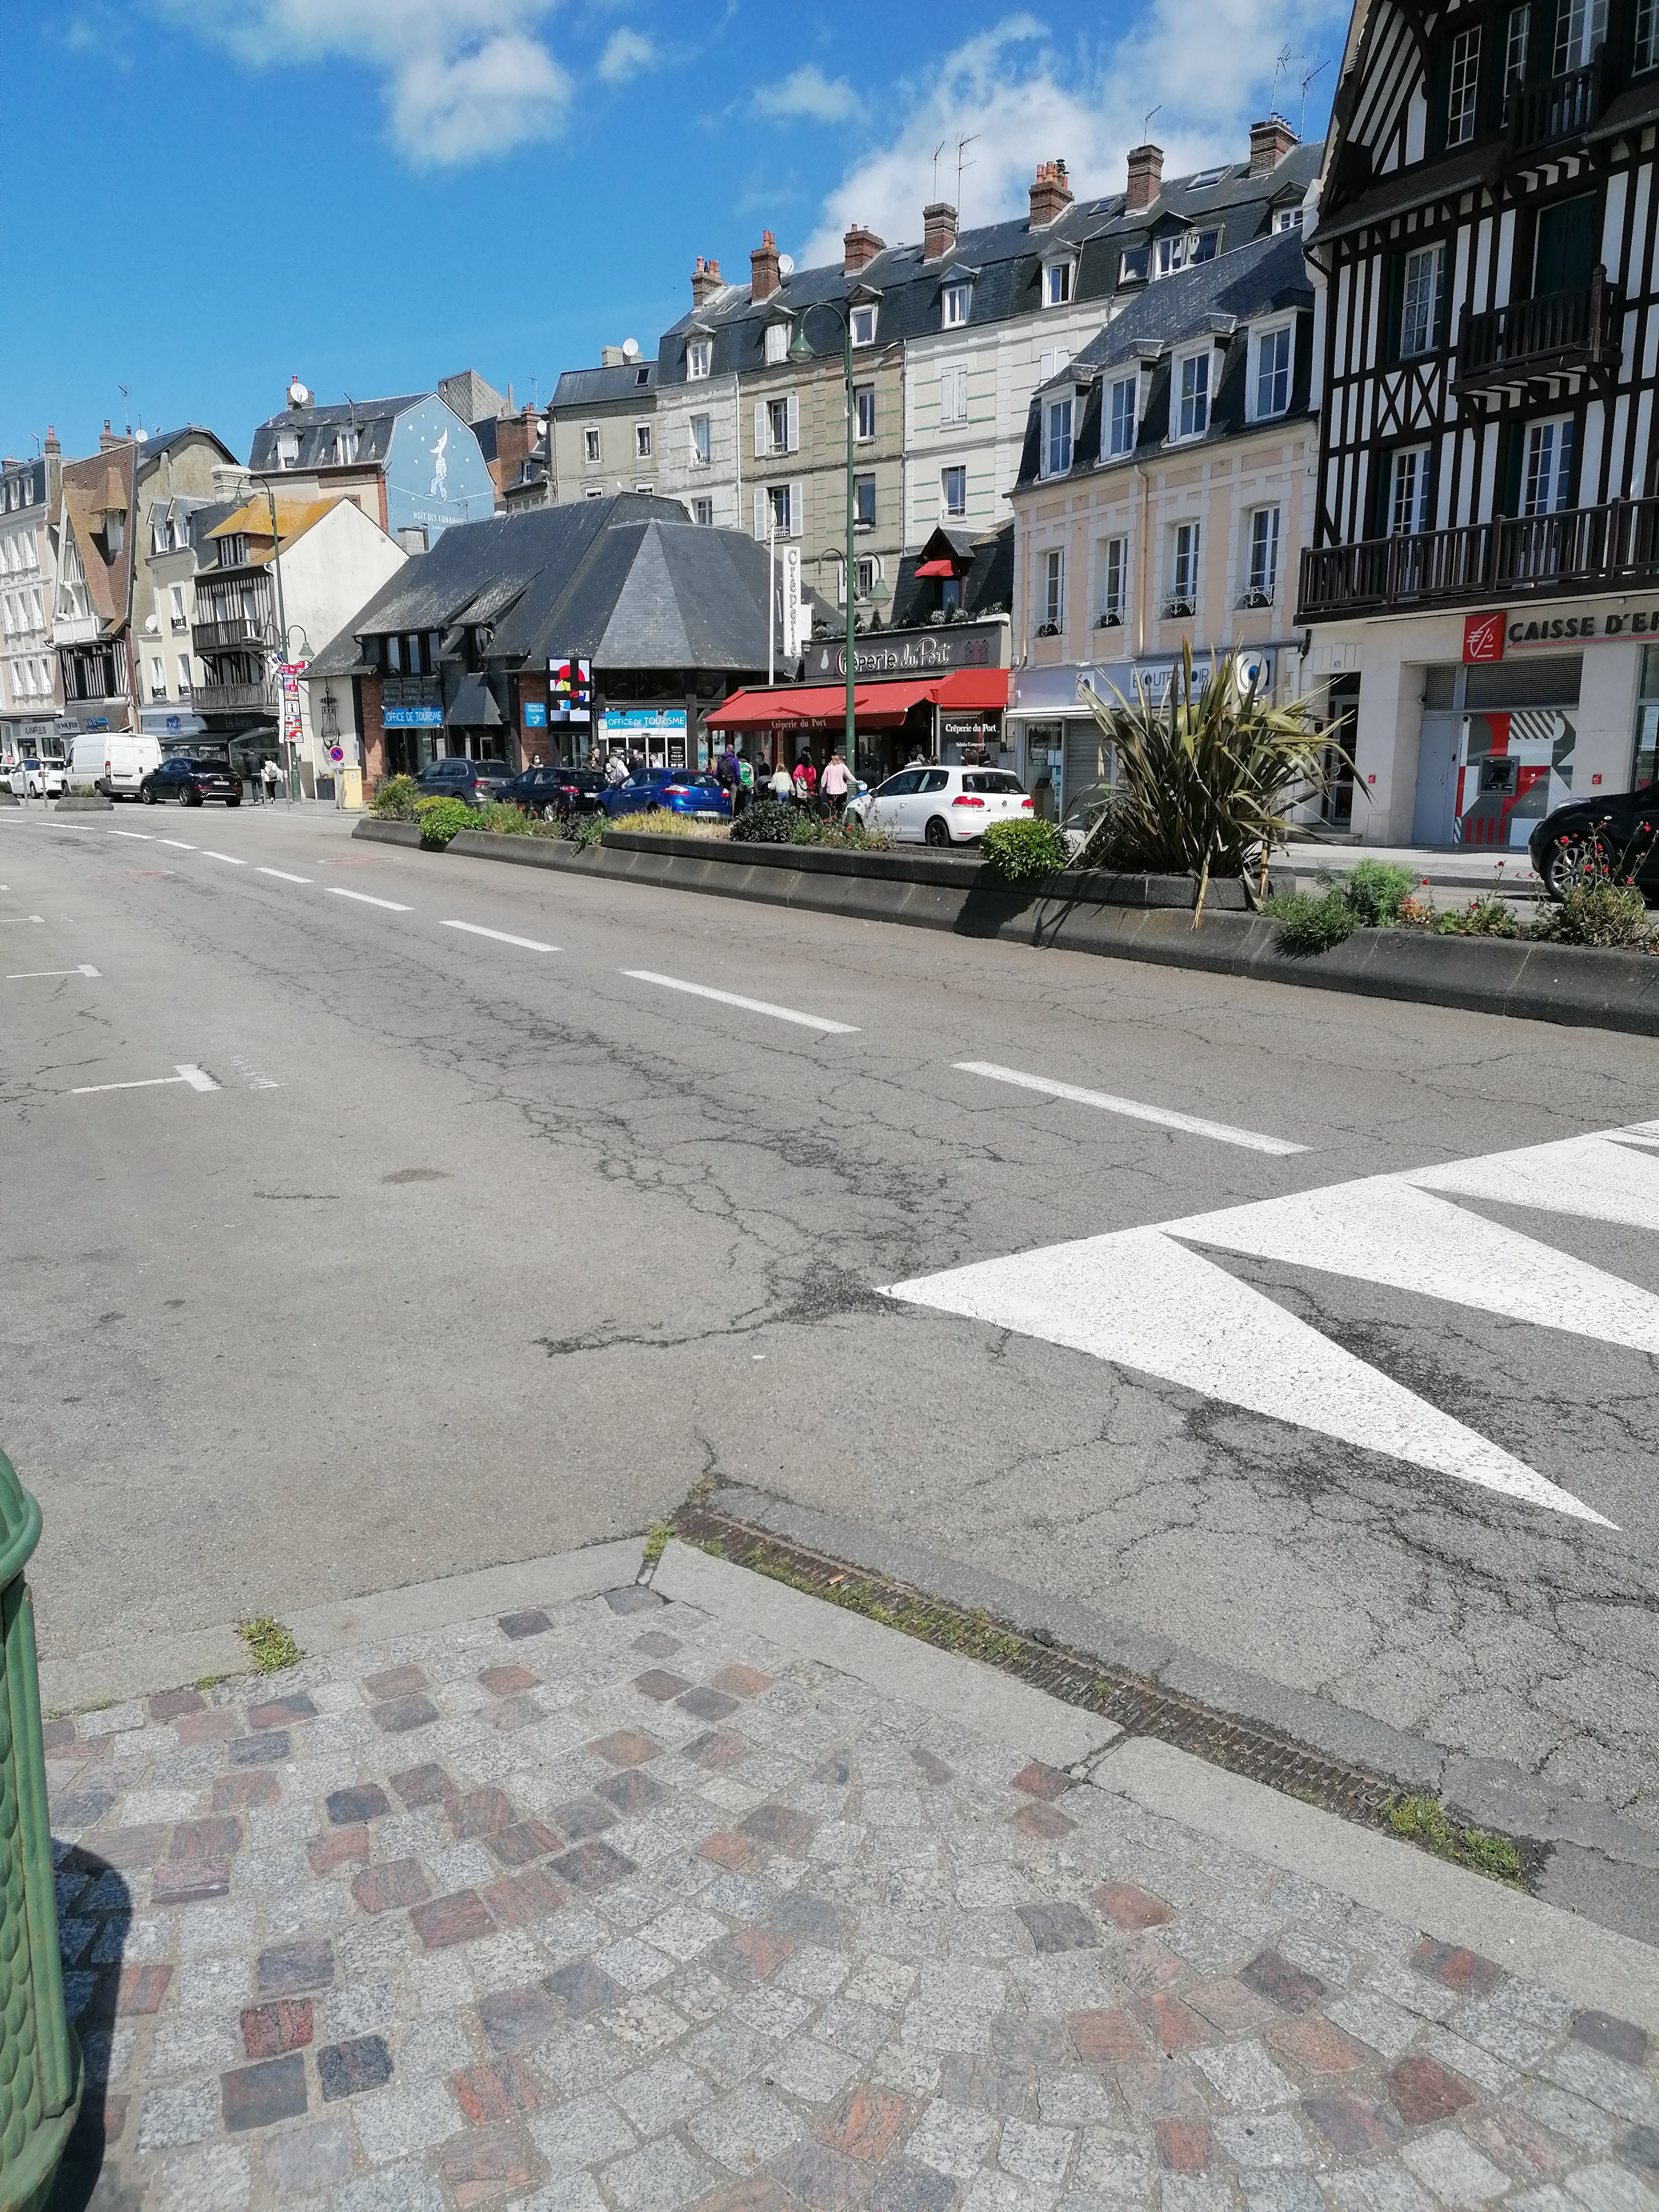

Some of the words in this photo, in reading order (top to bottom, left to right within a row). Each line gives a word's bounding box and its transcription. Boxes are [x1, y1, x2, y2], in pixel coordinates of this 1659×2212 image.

[788, 549, 798, 658] Crêperie
[1508, 616, 1595, 642] CAISSE
[900, 643, 919, 668] du
[915, 637, 951, 666] Port
[386, 712, 405, 722] OFFICE
[406, 712, 414, 722] DE
[415, 711, 442, 721] TOURISME
[644, 717, 685, 725] TOURISME
[771, 720, 797, 731] Crêperie
[800, 719, 809, 728] du
[811, 718, 827, 727] Port
[945, 723, 972, 734] Crêperie
[973, 723, 981, 732] du
[982, 723, 997, 732] Port
